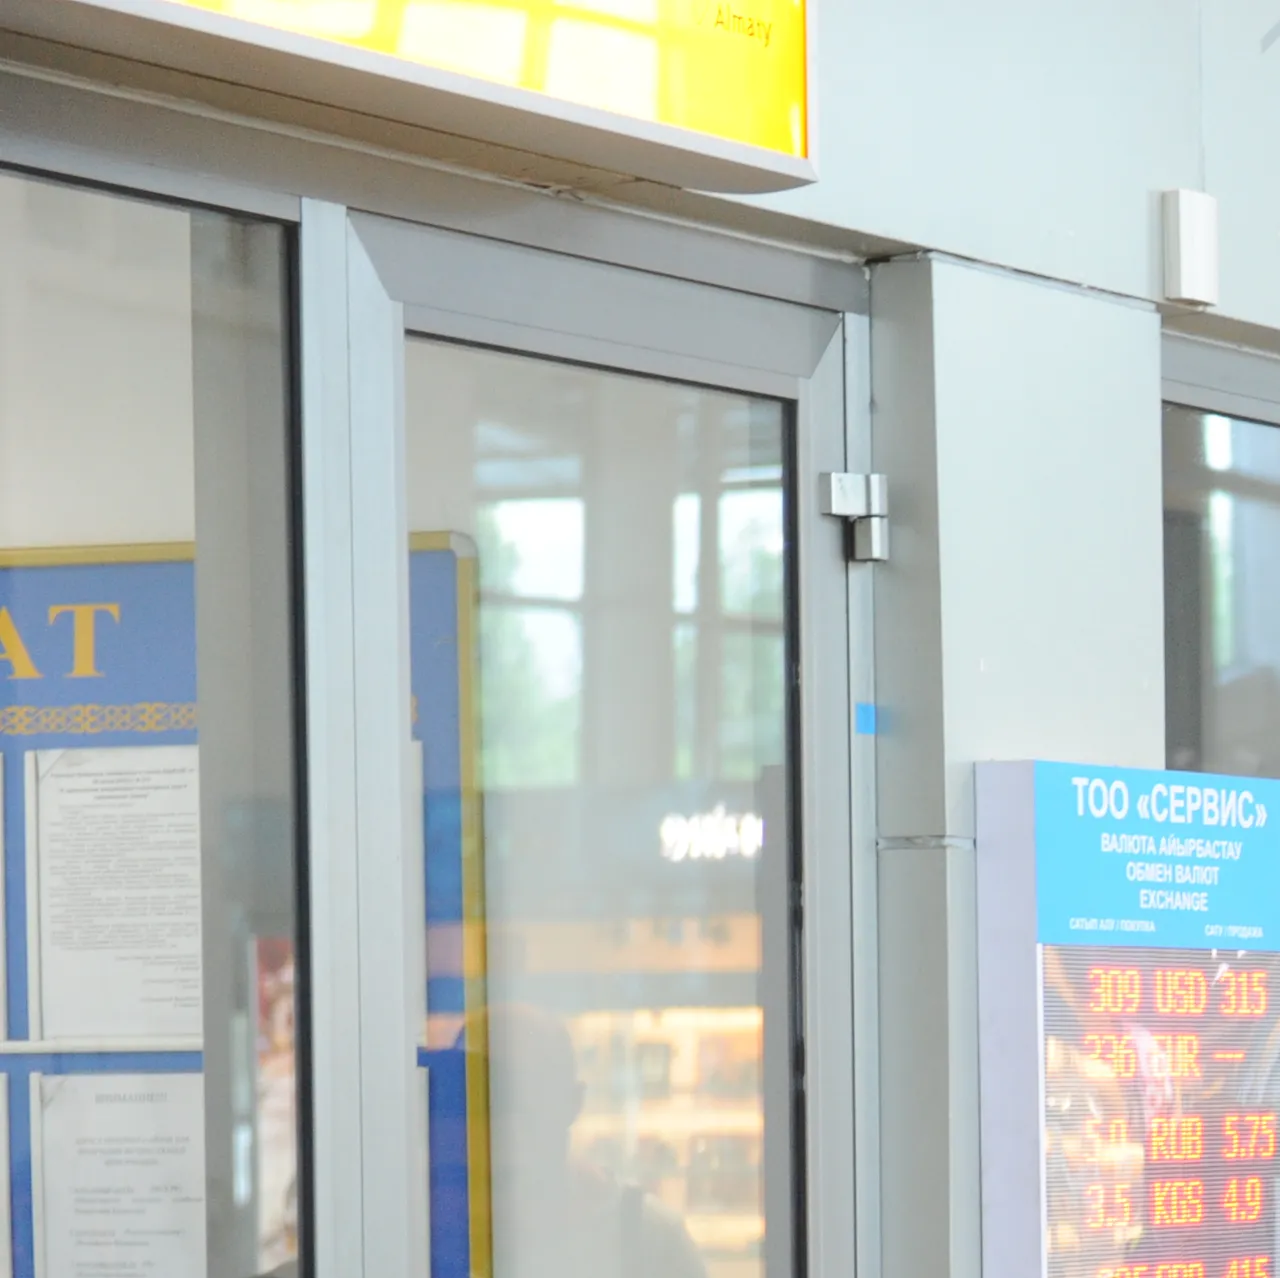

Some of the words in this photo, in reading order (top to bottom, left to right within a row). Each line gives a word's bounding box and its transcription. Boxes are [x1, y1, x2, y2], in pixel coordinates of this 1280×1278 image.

[1071, 776, 1129, 820] ТОО
[1137, 783, 1268, 828] «СЕРВИС»
[1101, 832, 1156, 855] ВАЛЮТА
[1159, 834, 1242, 860] АЙЫРБАСТАУ
[1126, 861, 1173, 883] ОБМЕН
[1175, 864, 1219, 885] ВАЛЮТ
[1139, 889, 1208, 911] EXCHANGE
[1088, 967, 1141, 1013] 309
[1154, 969, 1208, 1014] USD
[1151, 1117, 1203, 1160] RUB
[1222, 1114, 1277, 1159] 5.75
[1153, 1179, 1204, 1225] KGS
[1223, 1177, 1262, 1222] 4.9
